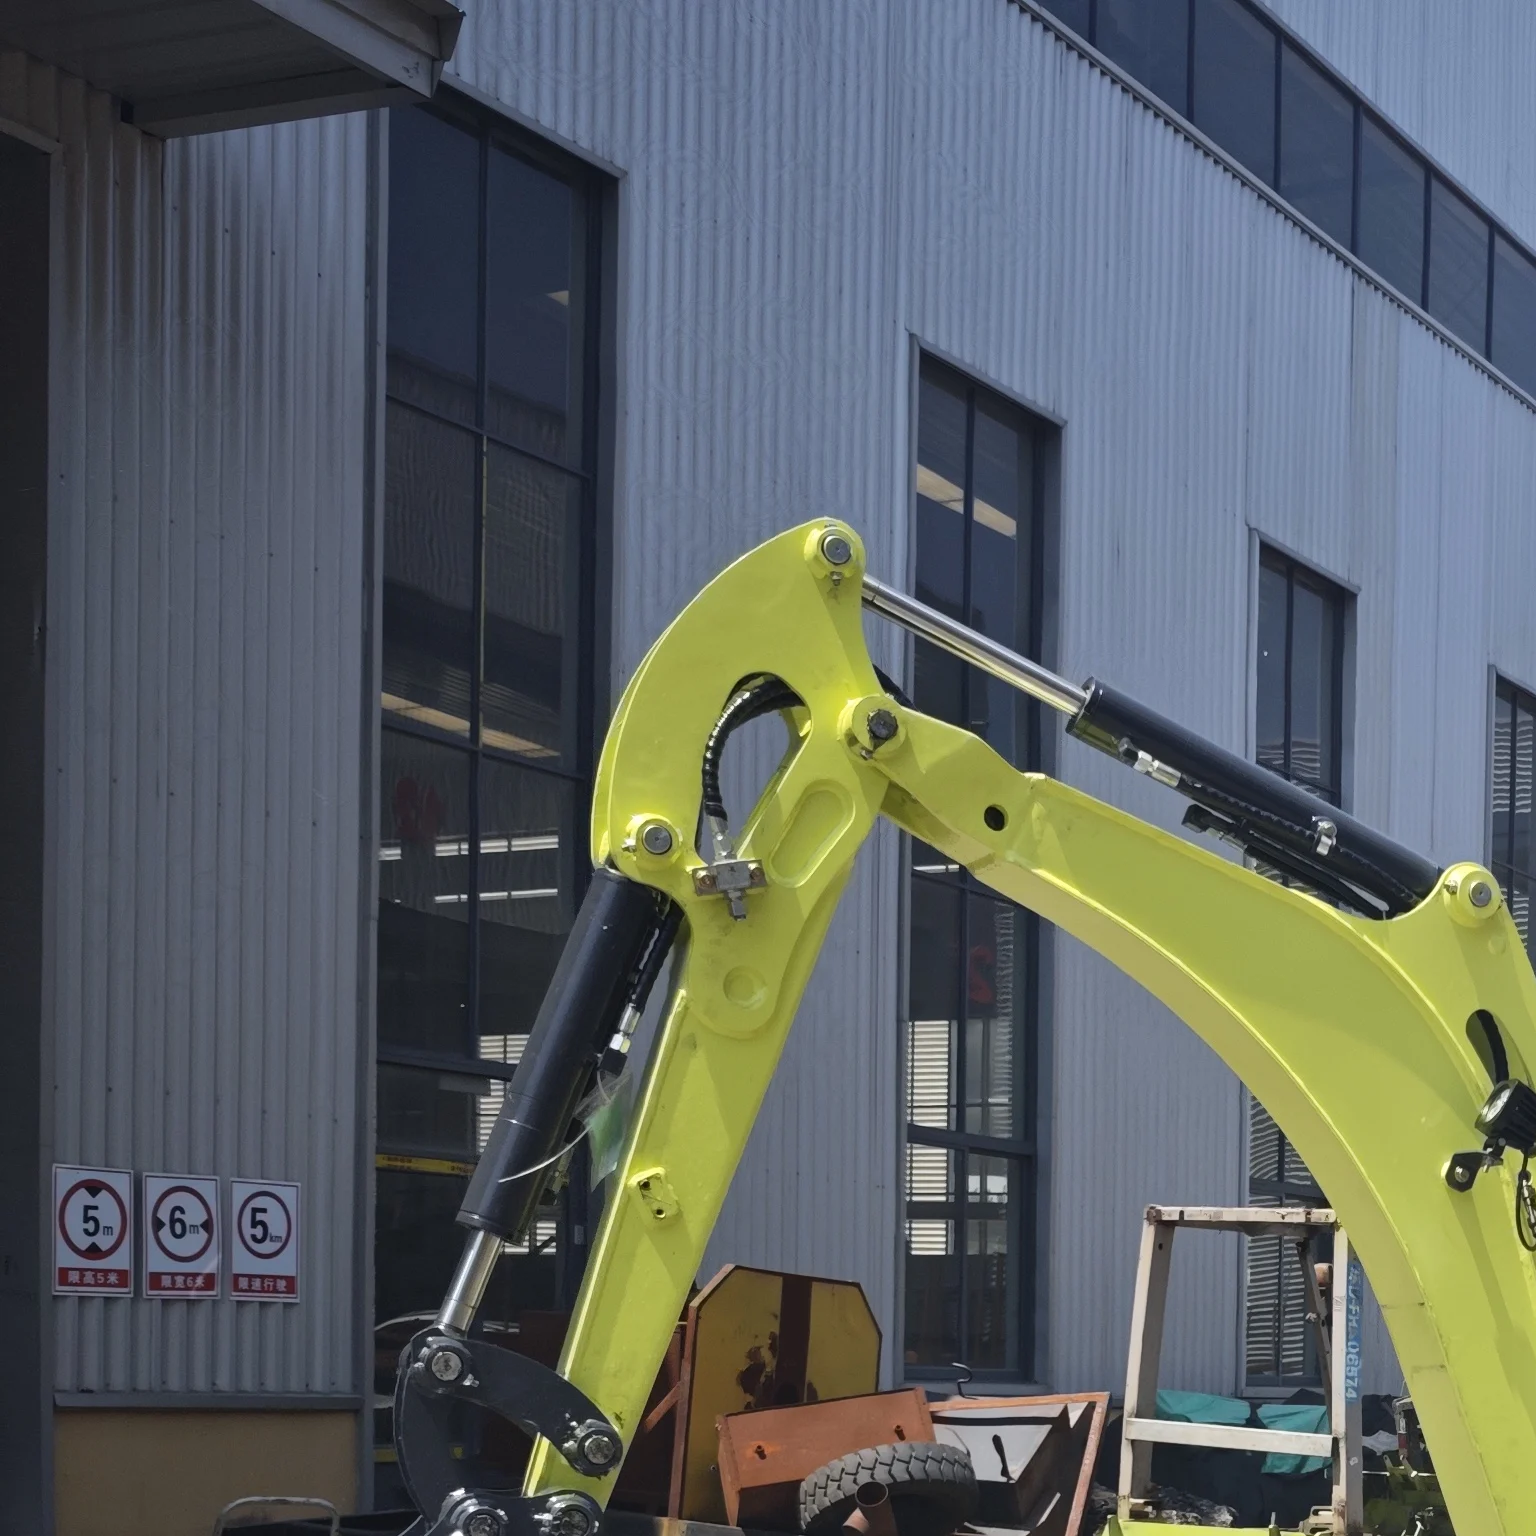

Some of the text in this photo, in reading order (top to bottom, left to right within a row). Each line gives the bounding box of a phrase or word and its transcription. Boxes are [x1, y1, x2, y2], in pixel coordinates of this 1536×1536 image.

[68, 1270, 119, 1285] 限高5米
[160, 1274, 206, 1289] 限宽6米
